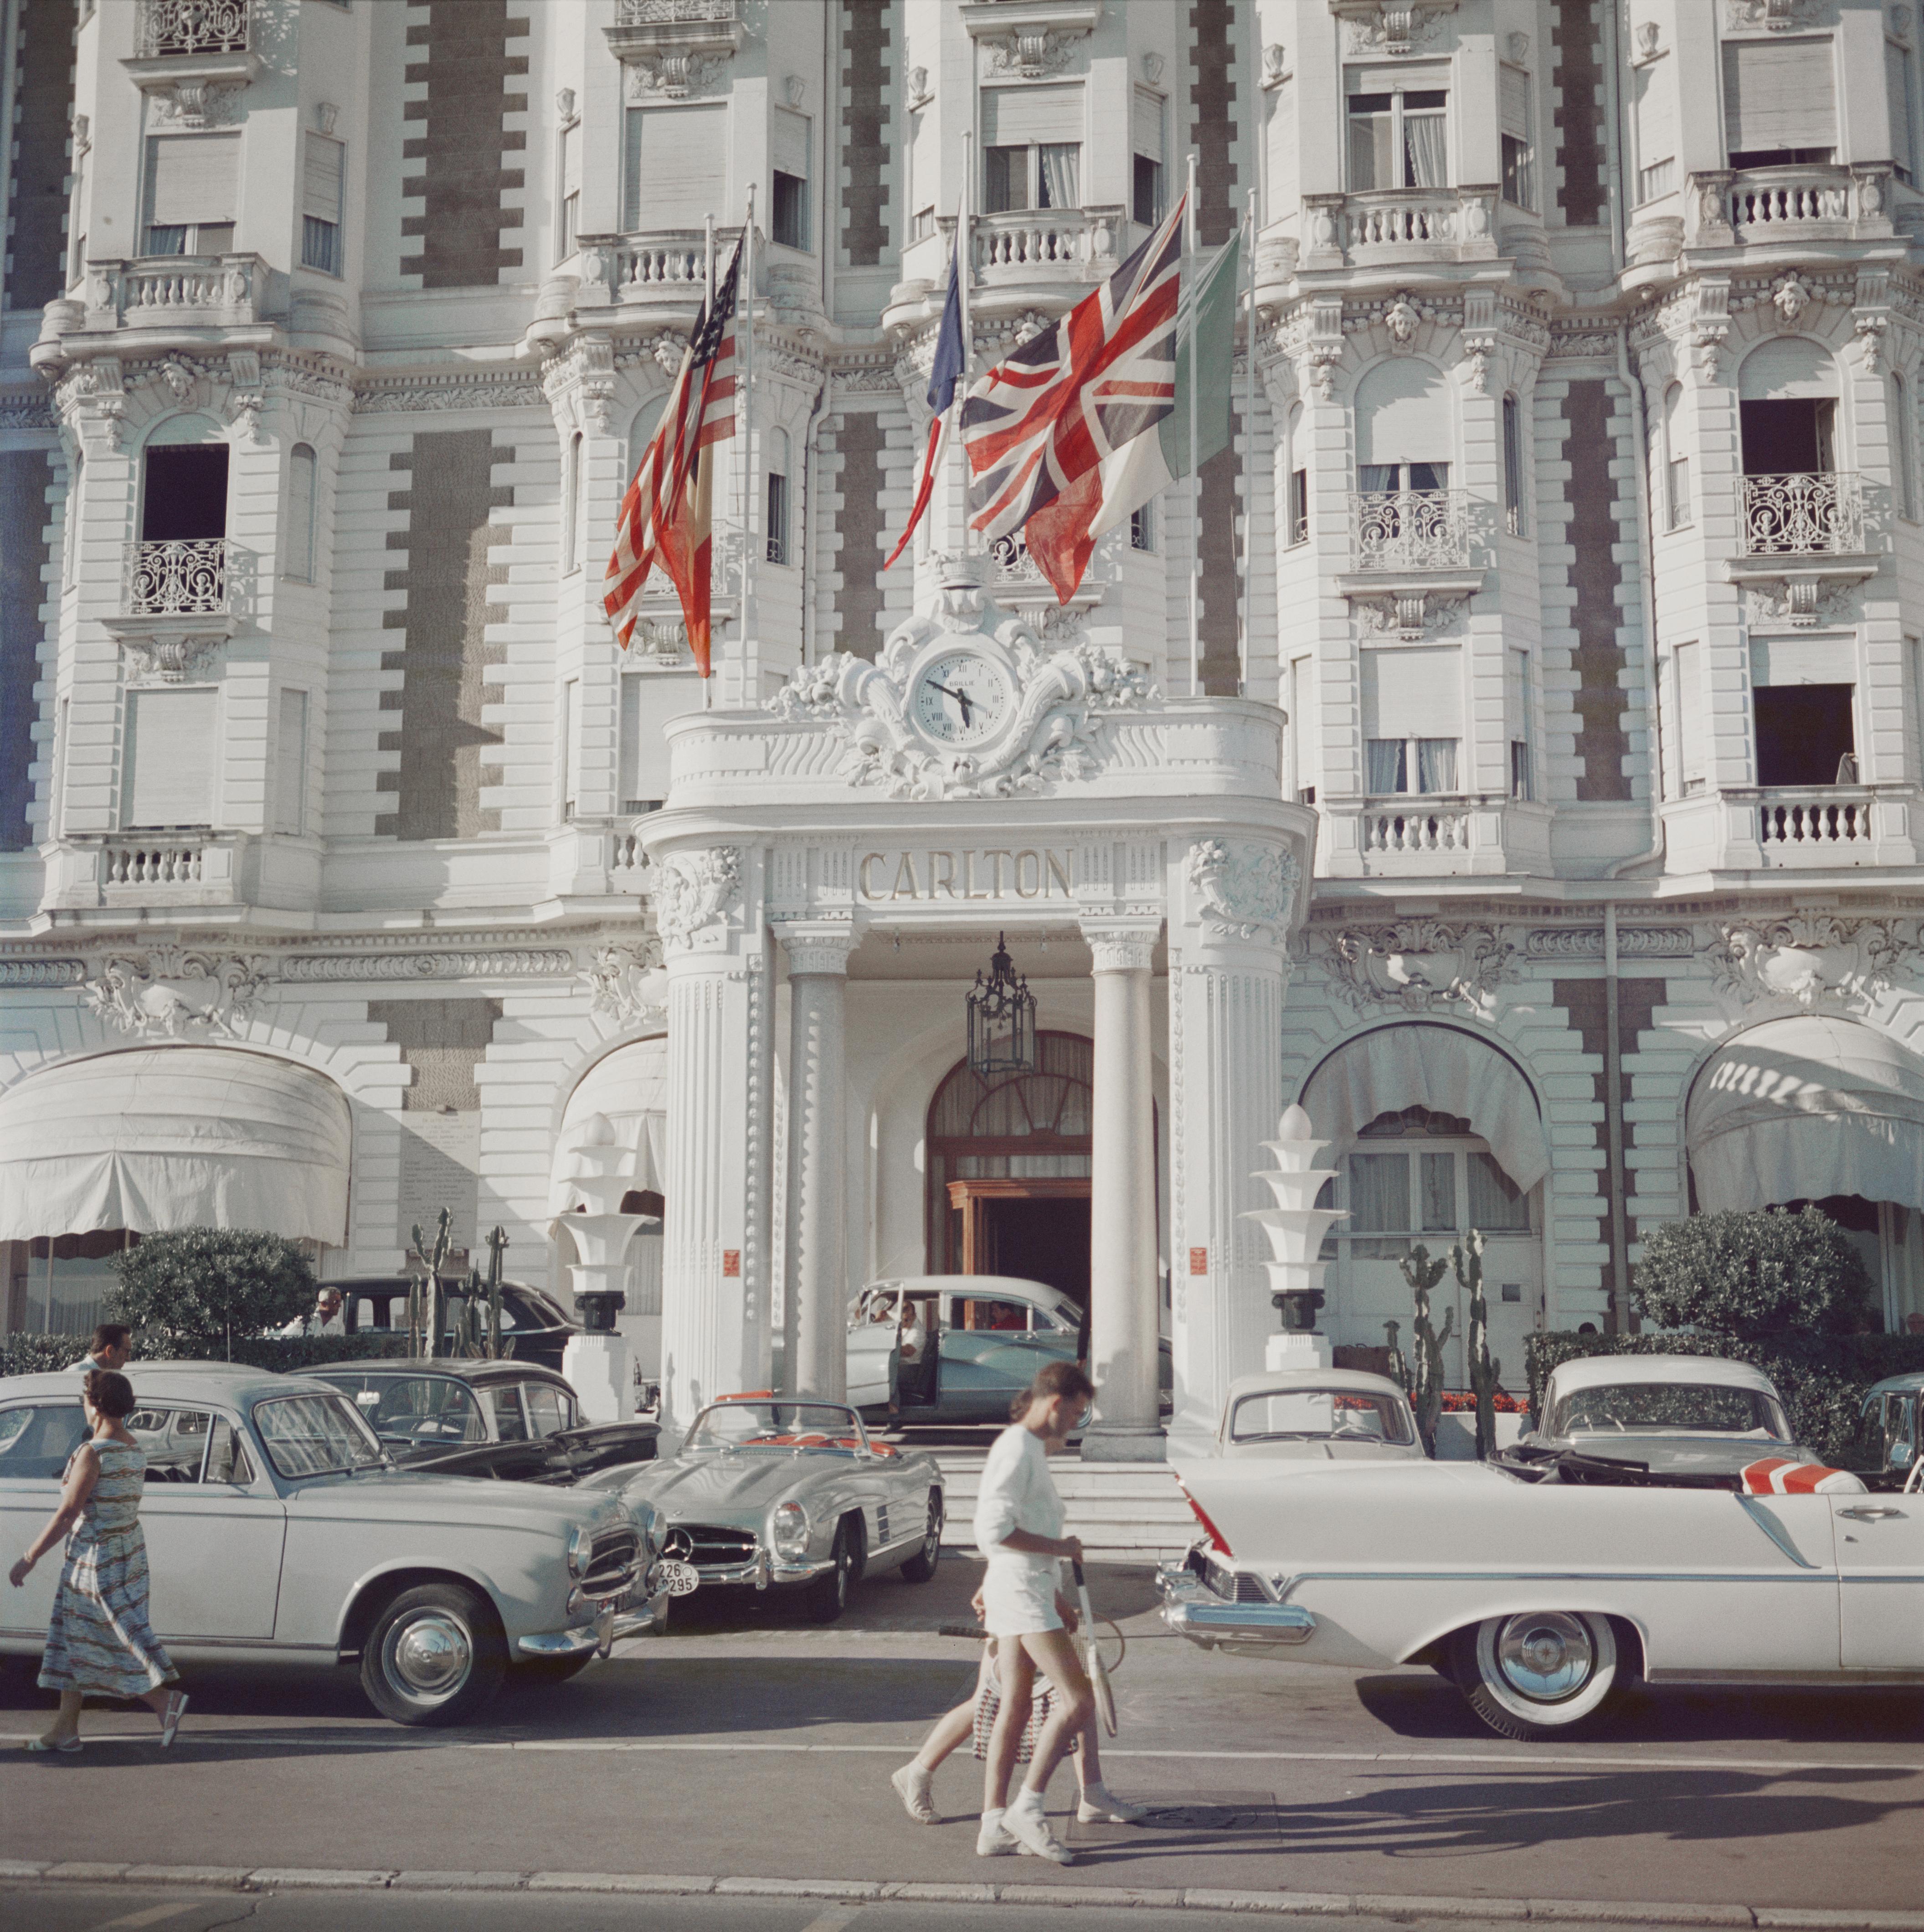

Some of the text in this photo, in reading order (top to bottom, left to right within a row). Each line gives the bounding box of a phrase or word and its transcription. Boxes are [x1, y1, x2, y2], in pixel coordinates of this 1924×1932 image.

[958, 664, 967, 673] XII
[988, 679, 993, 687] II
[926, 697, 933, 705] IX
[931, 712, 942, 721] VIII
[986, 711, 993, 719] IV
[943, 723, 952, 731] VII
[959, 726, 965, 734] VI
[859, 848, 1074, 901] CARLTON
[658, 1563, 681, 1577] 226
